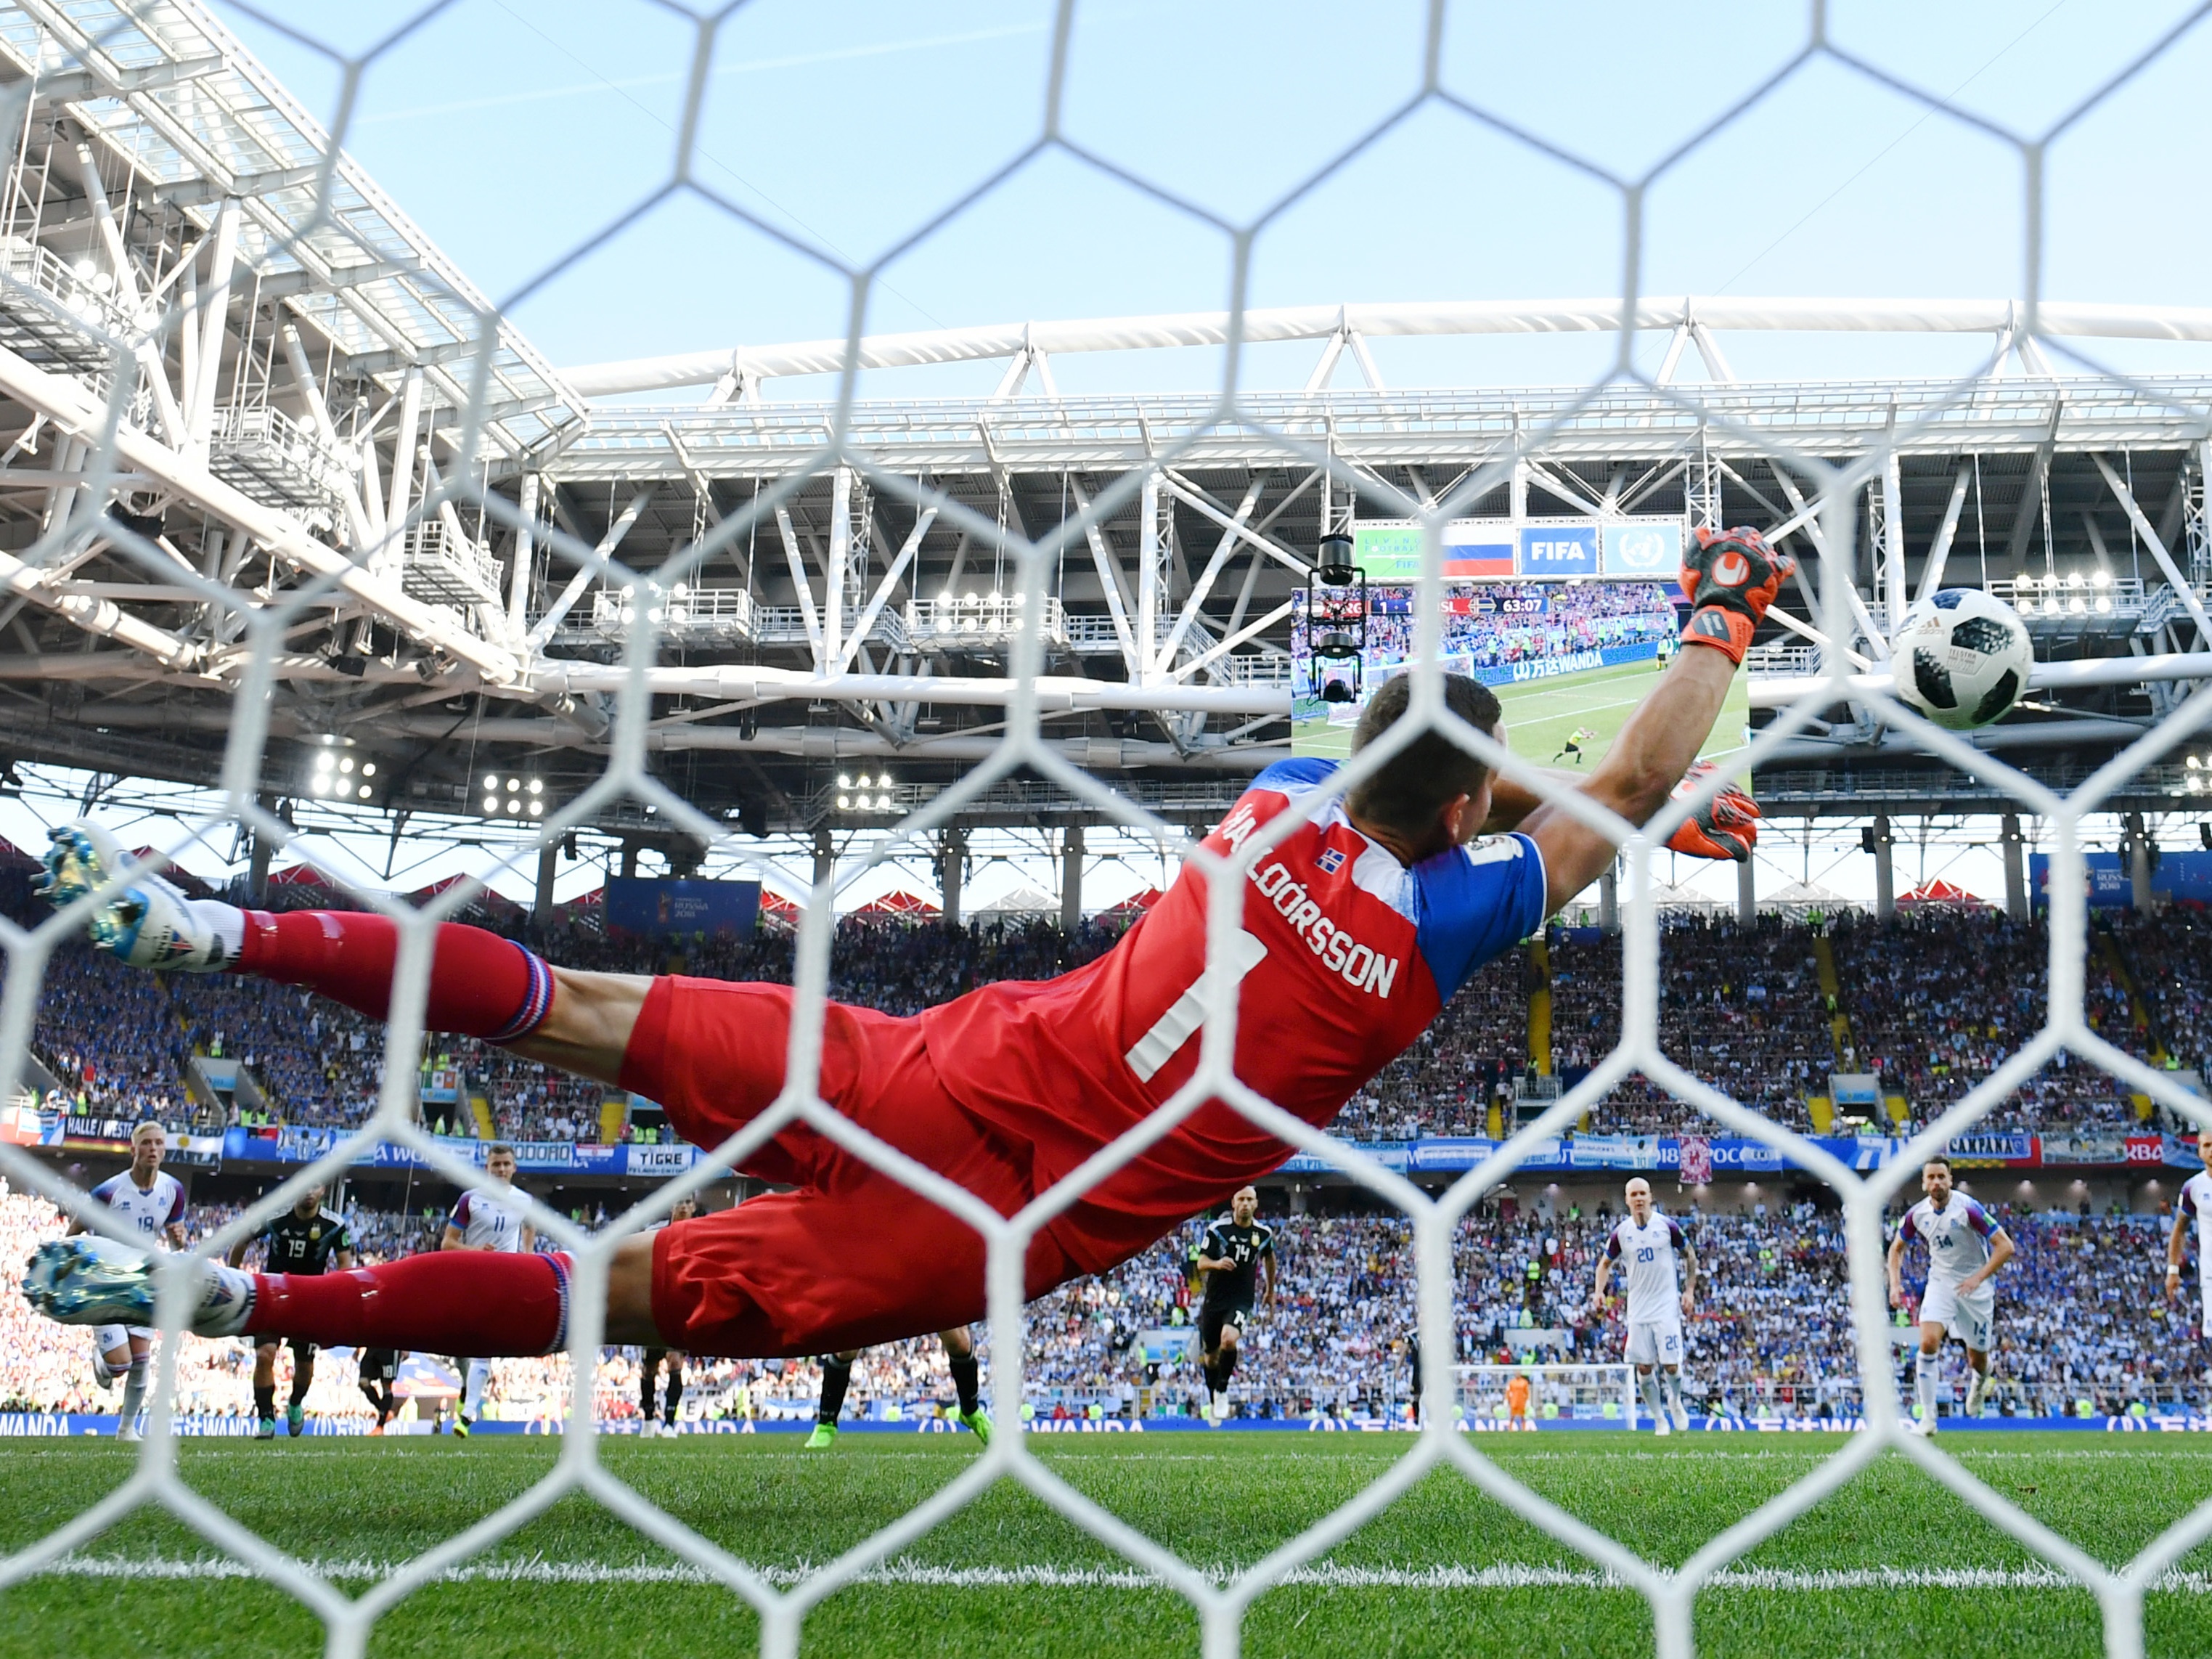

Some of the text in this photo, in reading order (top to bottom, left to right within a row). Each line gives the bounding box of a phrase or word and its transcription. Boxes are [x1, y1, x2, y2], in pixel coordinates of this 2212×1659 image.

[1531, 542, 1585, 561] FIFA
[1379, 601, 1387, 614] 1
[1503, 600, 1542, 613] 63:07
[1558, 651, 1604, 673] WANDA
[67, 1117, 96, 1137] HALLE
[640, 1153, 682, 1165] TIGRE
[138, 1216, 155, 1232] 18
[494, 1216, 505, 1232] 11
[288, 1239, 306, 1258] 19
[1235, 1244, 1250, 1262] 14
[1637, 1247, 1654, 1263] 20
[0, 1414, 70, 1436] WANDA
